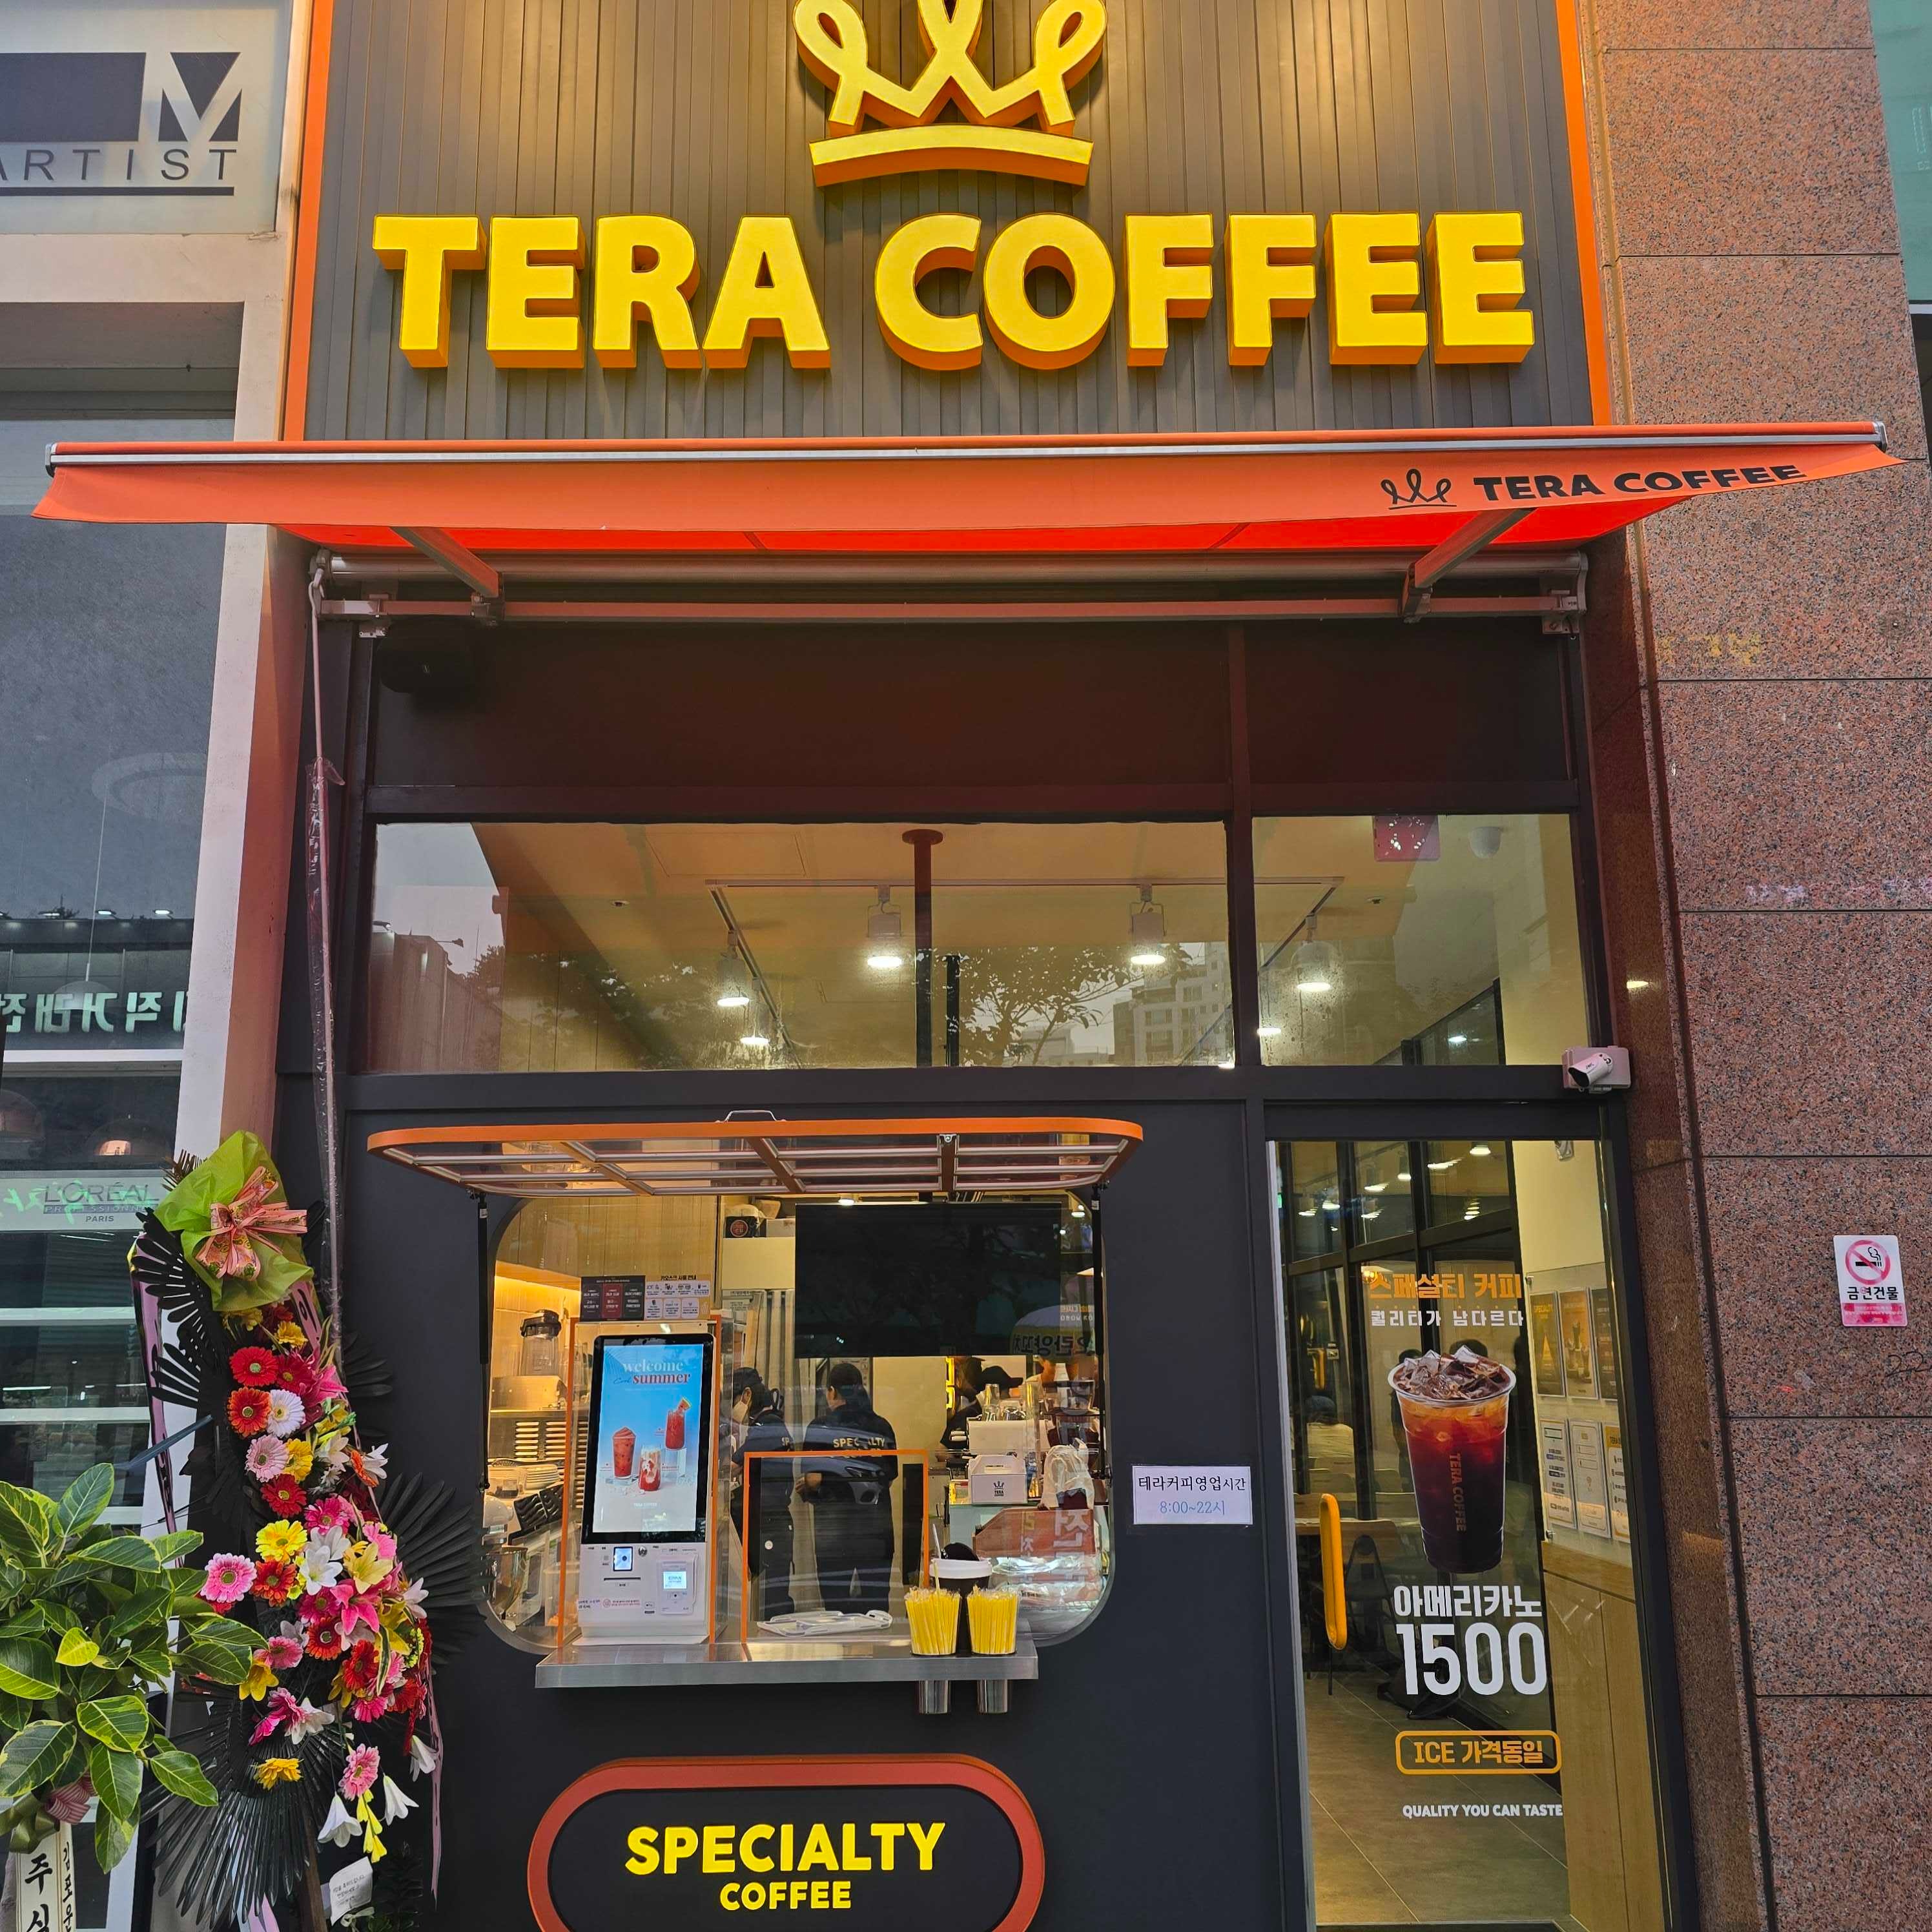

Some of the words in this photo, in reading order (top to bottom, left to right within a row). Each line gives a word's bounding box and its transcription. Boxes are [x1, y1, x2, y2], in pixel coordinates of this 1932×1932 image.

[0, 149, 236, 181] RTIST
[372, 214, 831, 370] TERA
[874, 212, 1534, 371] COFFEE
[1474, 474, 1605, 501] TERA
[1613, 464, 1807, 493] COFFEE
[1370, 1273, 1465, 1299] 스페셜티
[1474, 1273, 1523, 1299] 커피
[1847, 1286, 1898, 1300] 금연건물
[1371, 1310, 1442, 1327] 퀄리티가
[1452, 1310, 1524, 1327] 남다르다
[622, 1358, 683, 1372] welcome
[633, 1373, 690, 1385] summer
[832, 1437, 885, 1448] SPECALTY
[1449, 1452, 1463, 1485] TERA
[1160, 1500, 1225, 1515] 8:00~22시
[1452, 1486, 1467, 1532] COFFEE
[1393, 1585, 1543, 1617] 아메리카노
[1396, 1622, 1547, 1696] 1500
[1414, 1742, 1455, 1763] ICE
[1461, 1740, 1543, 1763] 가격동일
[1403, 1805, 1459, 1818] QUALITY
[1461, 1805, 1490, 1817] YOU
[1493, 1804, 1520, 1817] CAN
[1523, 1804, 1563, 1816] TASTE
[625, 1822, 946, 1876] SPECIALTY
[720, 1880, 852, 1911] COFFEE
